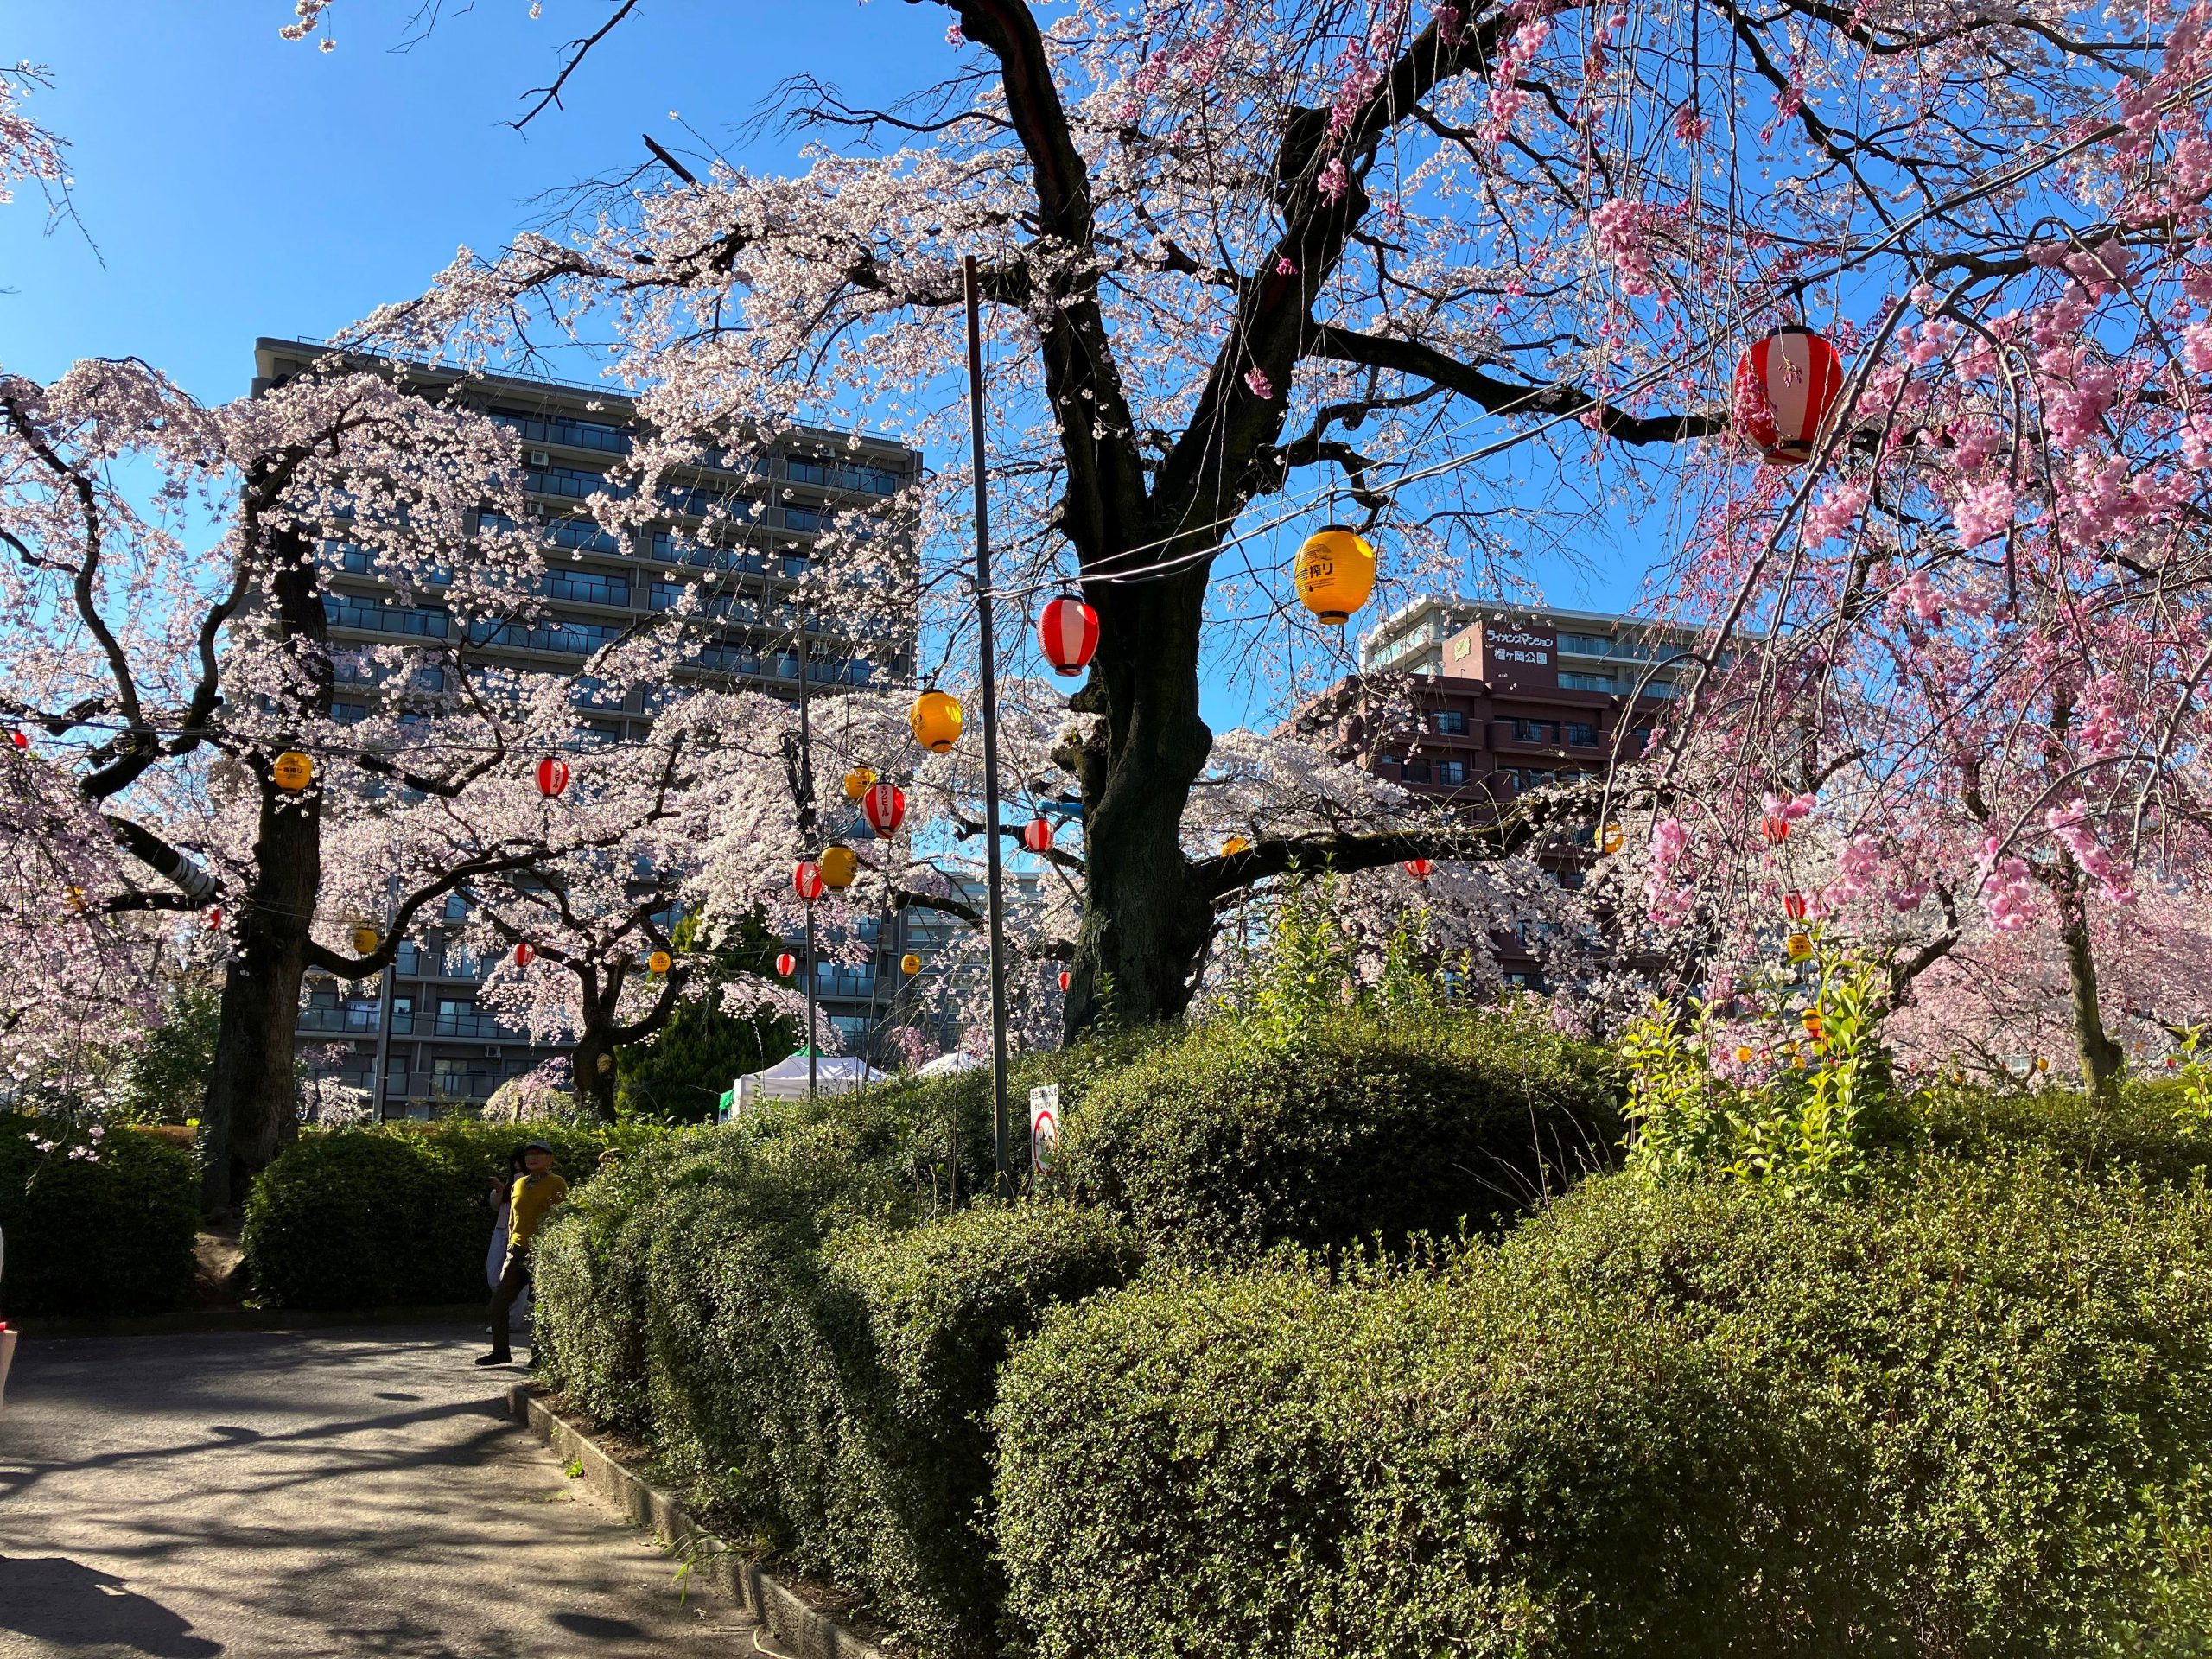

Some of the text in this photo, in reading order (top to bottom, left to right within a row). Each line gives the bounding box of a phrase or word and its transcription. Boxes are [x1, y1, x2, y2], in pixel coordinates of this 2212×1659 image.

[1486, 629, 1554, 647] ライオンズマンション
[881, 785, 890, 817] キリンビール
